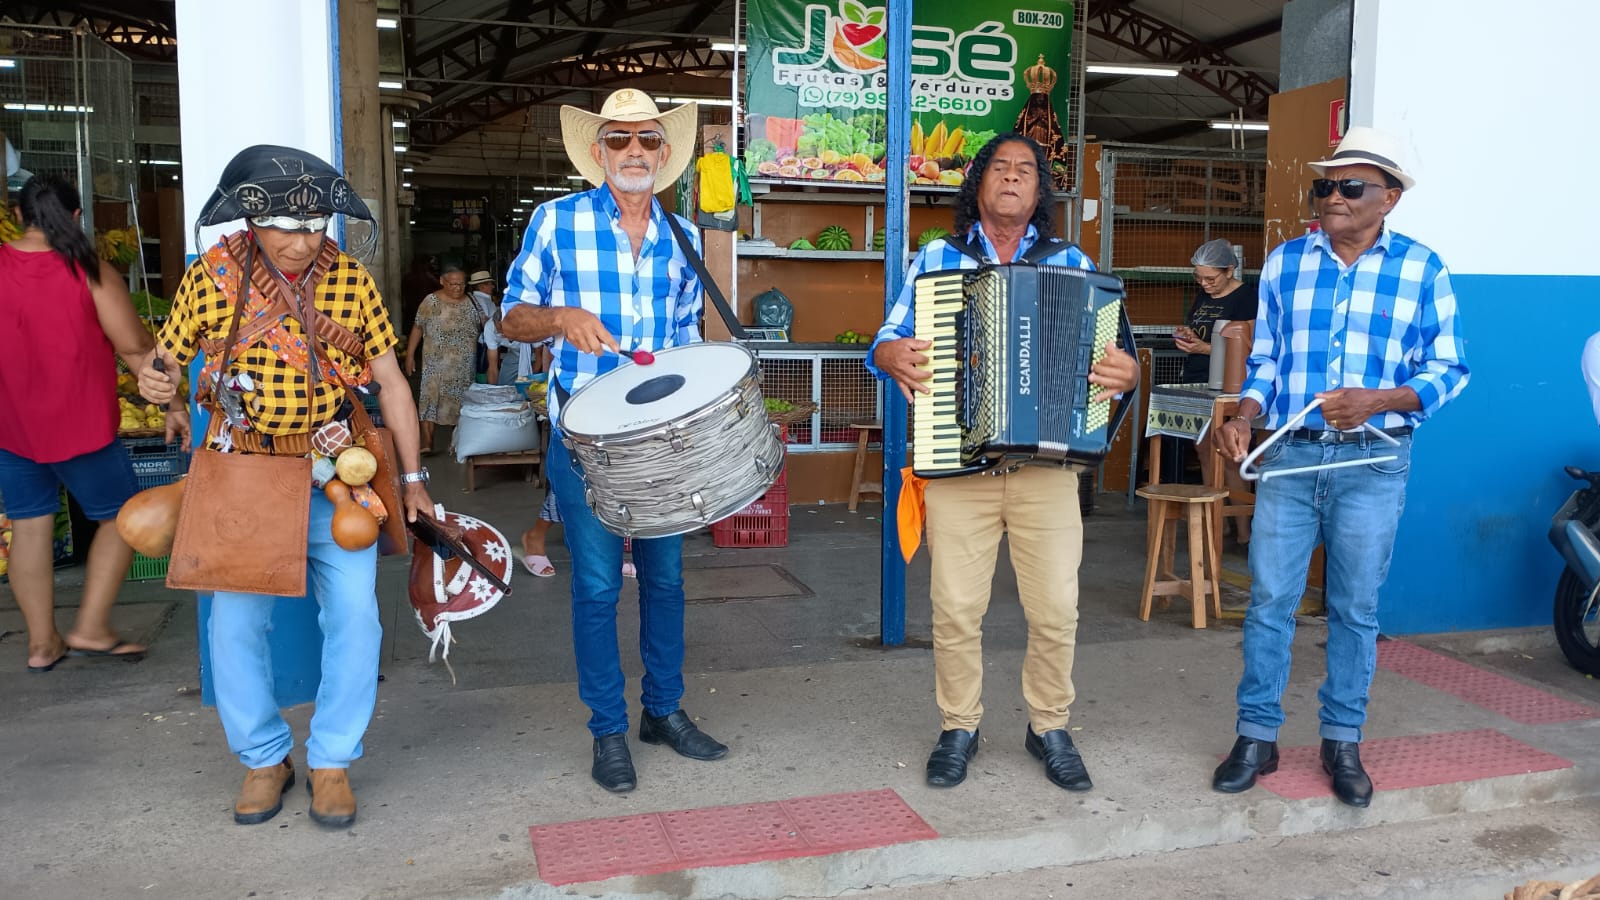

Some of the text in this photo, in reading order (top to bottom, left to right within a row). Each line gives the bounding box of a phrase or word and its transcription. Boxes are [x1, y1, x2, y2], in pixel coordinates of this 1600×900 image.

[1018, 11, 1062, 27] BOX-240
[778, 70, 859, 86] Frutas
[826, 91, 859, 106] (79)
[1019, 316, 1031, 395] SCANDALLI
